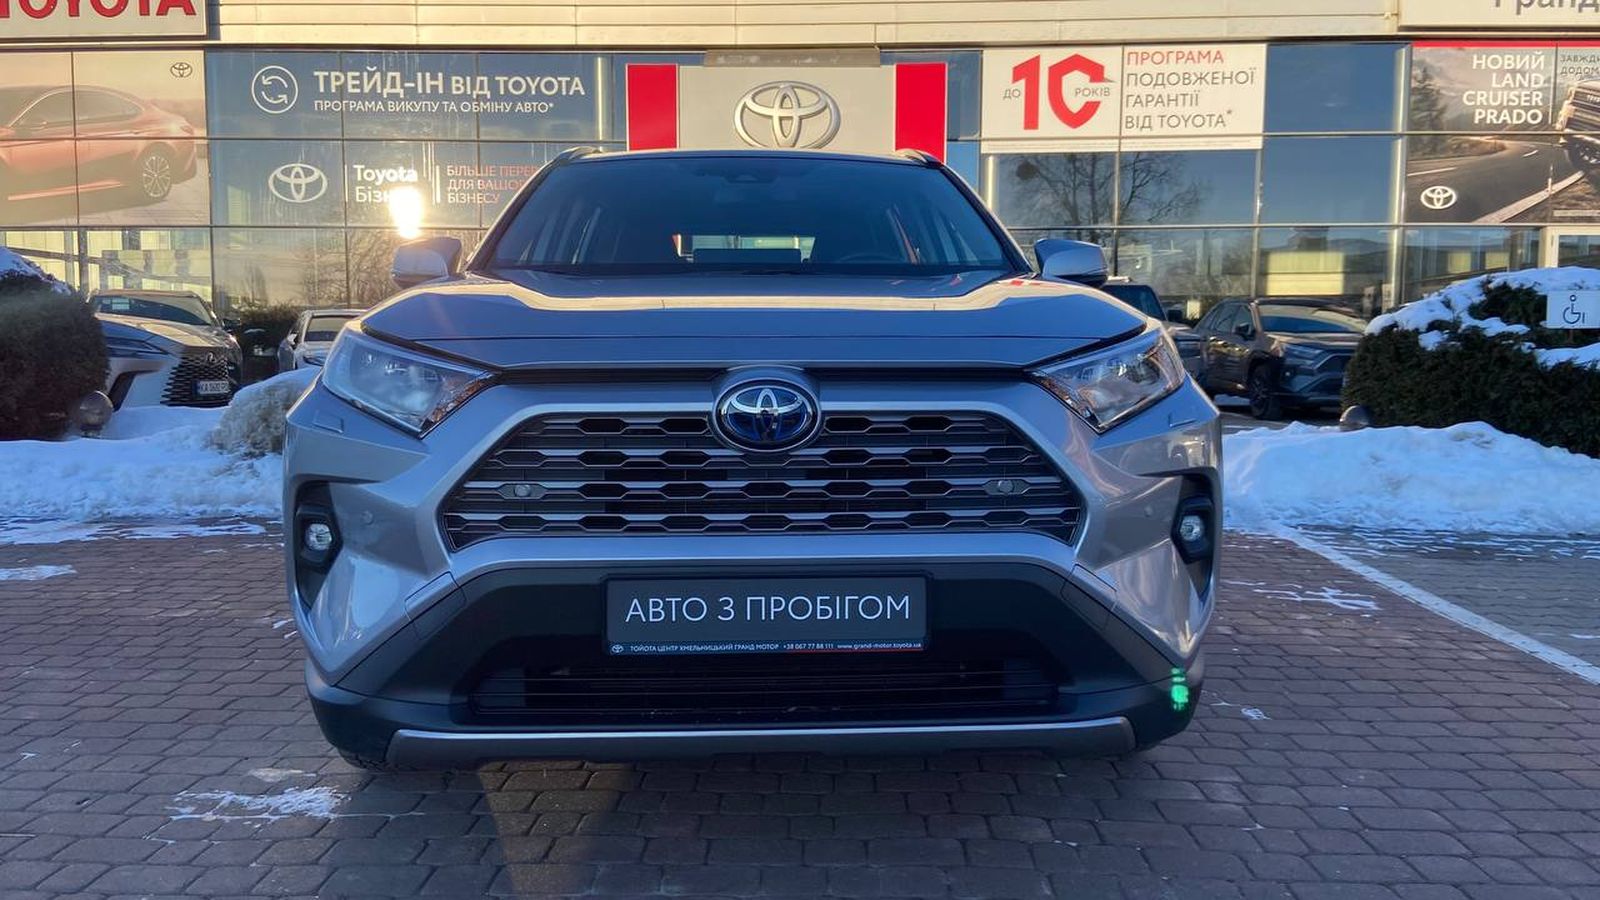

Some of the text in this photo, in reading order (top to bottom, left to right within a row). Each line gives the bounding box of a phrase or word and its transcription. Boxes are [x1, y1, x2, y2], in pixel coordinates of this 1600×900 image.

[1126, 50, 1225, 66] ПРОГРАМА
[1472, 51, 1545, 70] НОВИЙ
[313, 66, 586, 99] ТРЕЙД-ІН ВІД TOYOTA
[1126, 67, 1256, 88] ПОДОВЖЕНОЇ
[1491, 73, 1544, 88] LAND
[1003, 89, 1021, 100] ДО
[1075, 87, 1111, 98] РОКІВ
[1126, 90, 1201, 108] ГАРАНТІЇ
[1462, 90, 1543, 106] CRUISER
[314, 100, 385, 112] ПРОГРАМА
[387, 100, 440, 112] ВИКУПУ
[442, 101, 458, 113] ТА
[460, 101, 513, 114] ОБМІНУ
[1125, 115, 1152, 130] ВІД
[1474, 109, 1543, 125] PRADO
[352, 164, 419, 186] Toyota
[446, 165, 497, 177] БІЛЬШЕ
[448, 179, 474, 192] ДЛЯ
[447, 192, 500, 204] БІЗНЕСУ
[625, 598, 707, 622] АВТО
[746, 595, 910, 621] ПРОБІГОМ
[630, 643, 656, 652] ТОЙОТА
[657, 644, 678, 652] ЦЕНТР
[734, 643, 755, 651] ГРАНД
[756, 643, 779, 651] МОТОР
